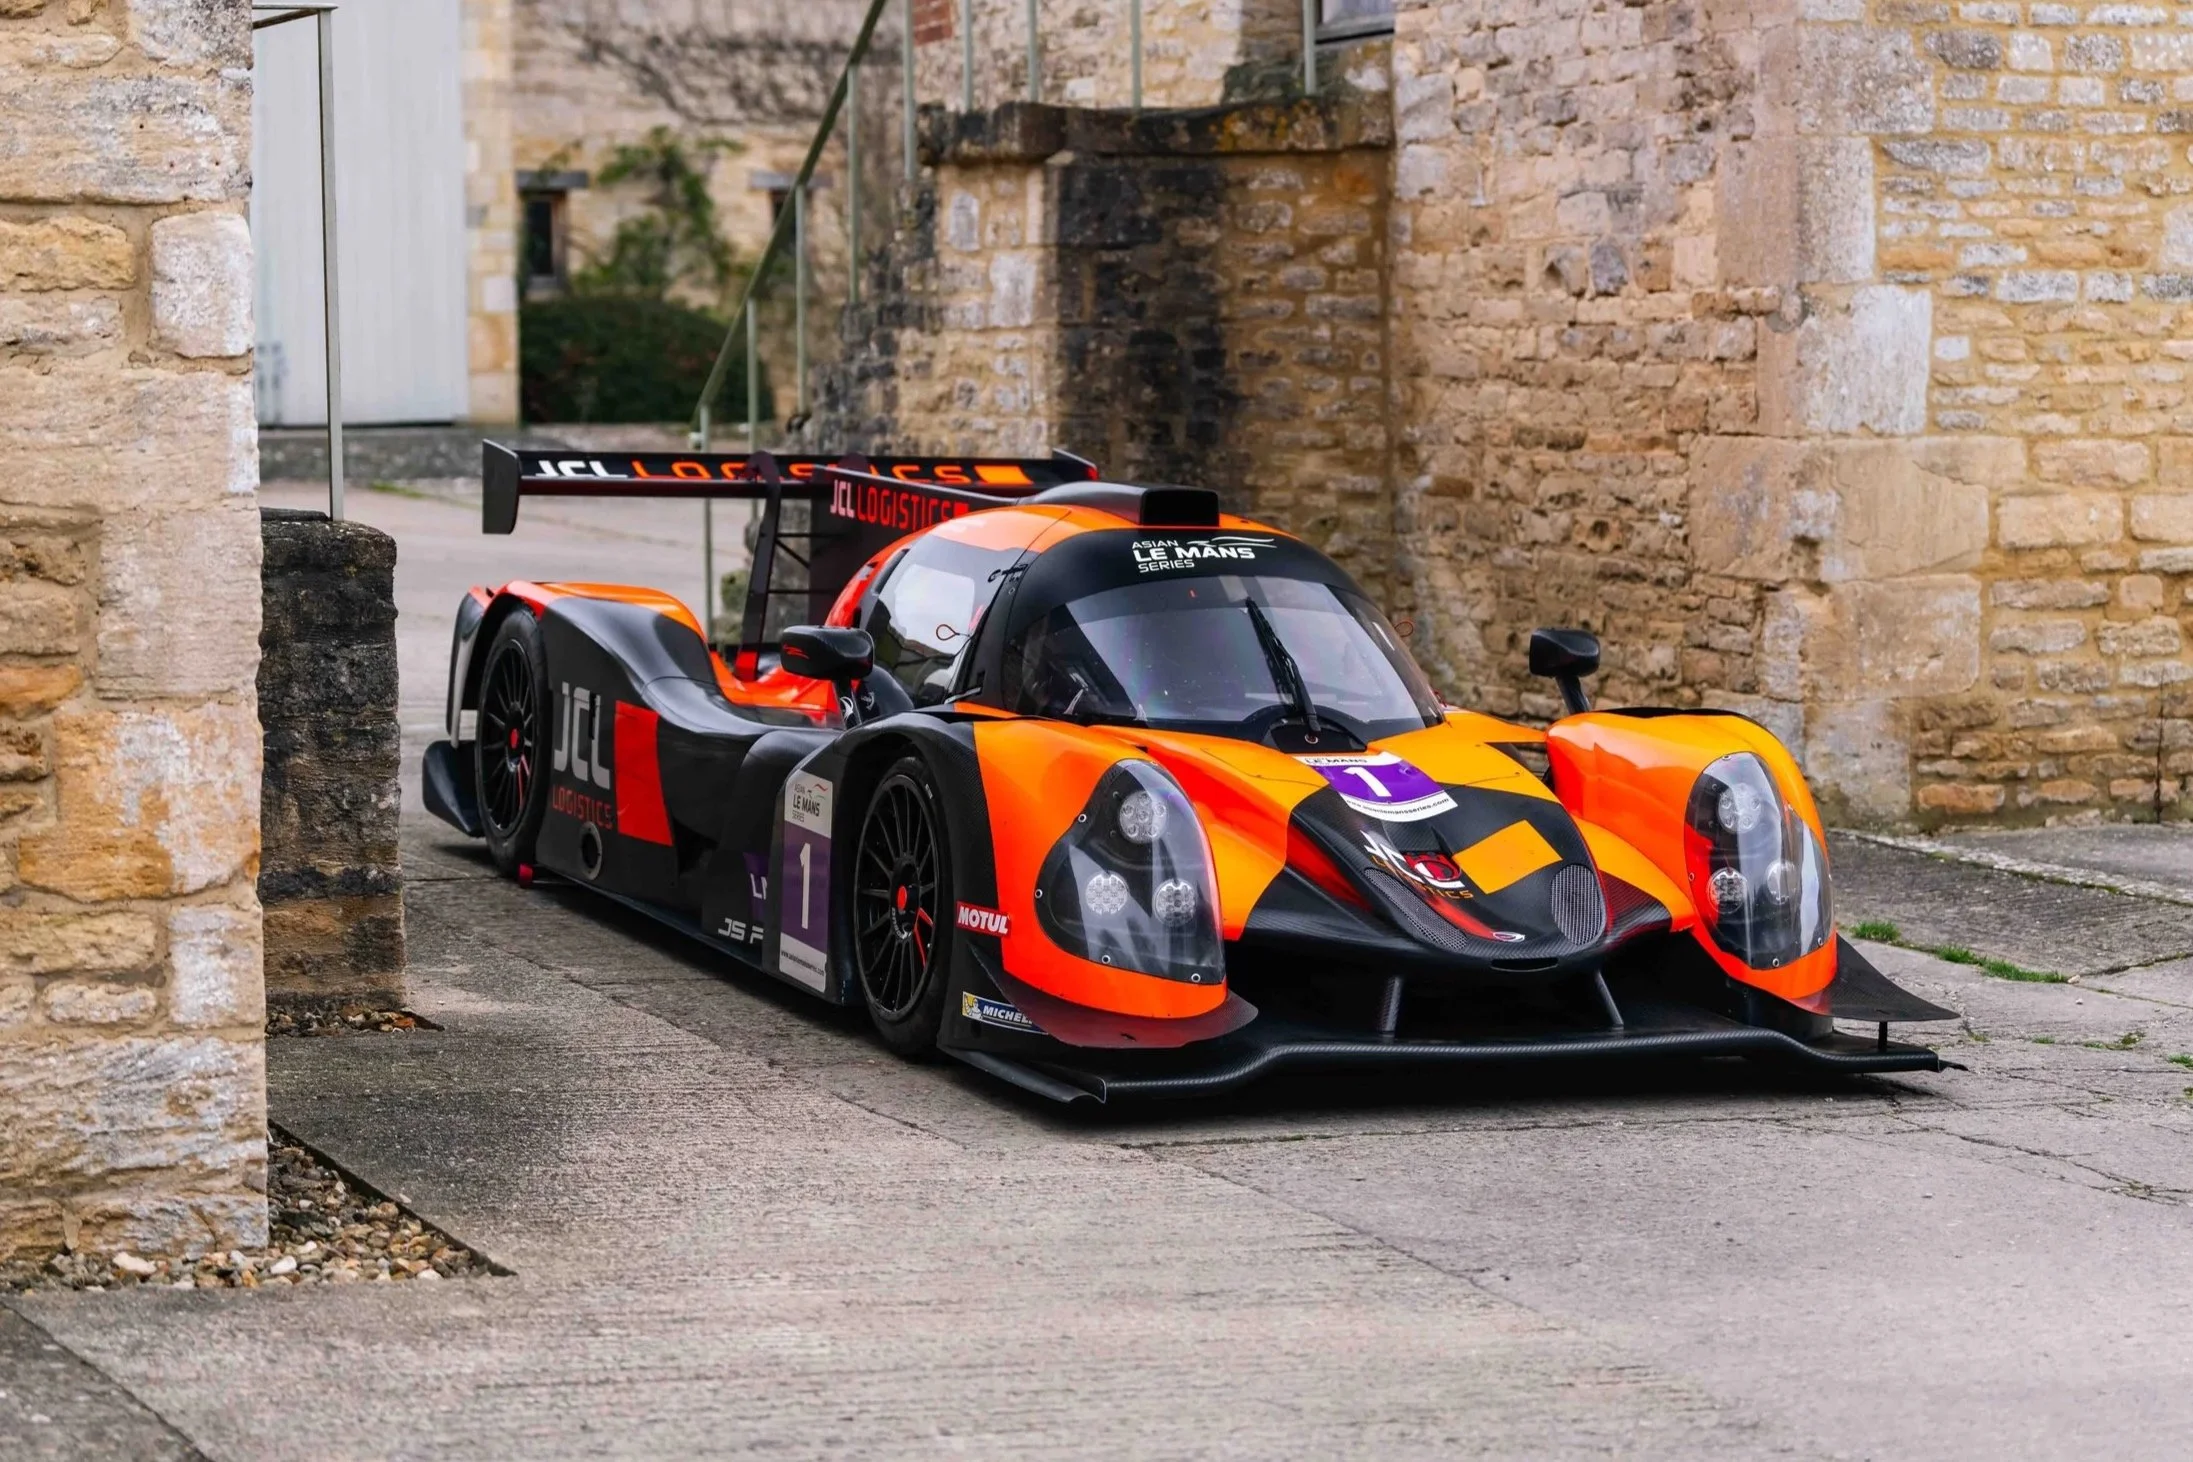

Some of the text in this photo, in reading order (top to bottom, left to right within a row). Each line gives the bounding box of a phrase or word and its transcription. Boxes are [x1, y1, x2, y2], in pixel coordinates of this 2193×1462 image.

[536, 460, 628, 478] JCL
[830, 479, 855, 519] JCL
[1132, 540, 1179, 549] ASIAN
[1133, 547, 1256, 562] LE MANS
[1138, 558, 1195, 573] SERIES
[554, 681, 610, 790] JCL
[1343, 766, 1393, 798] 1
[552, 785, 613, 830] LOGISTICS
[793, 794, 821, 817] LE MANS
[799, 842, 811, 930] 1
[718, 917, 747, 941] JS
[957, 906, 1009, 935] MOTUL
